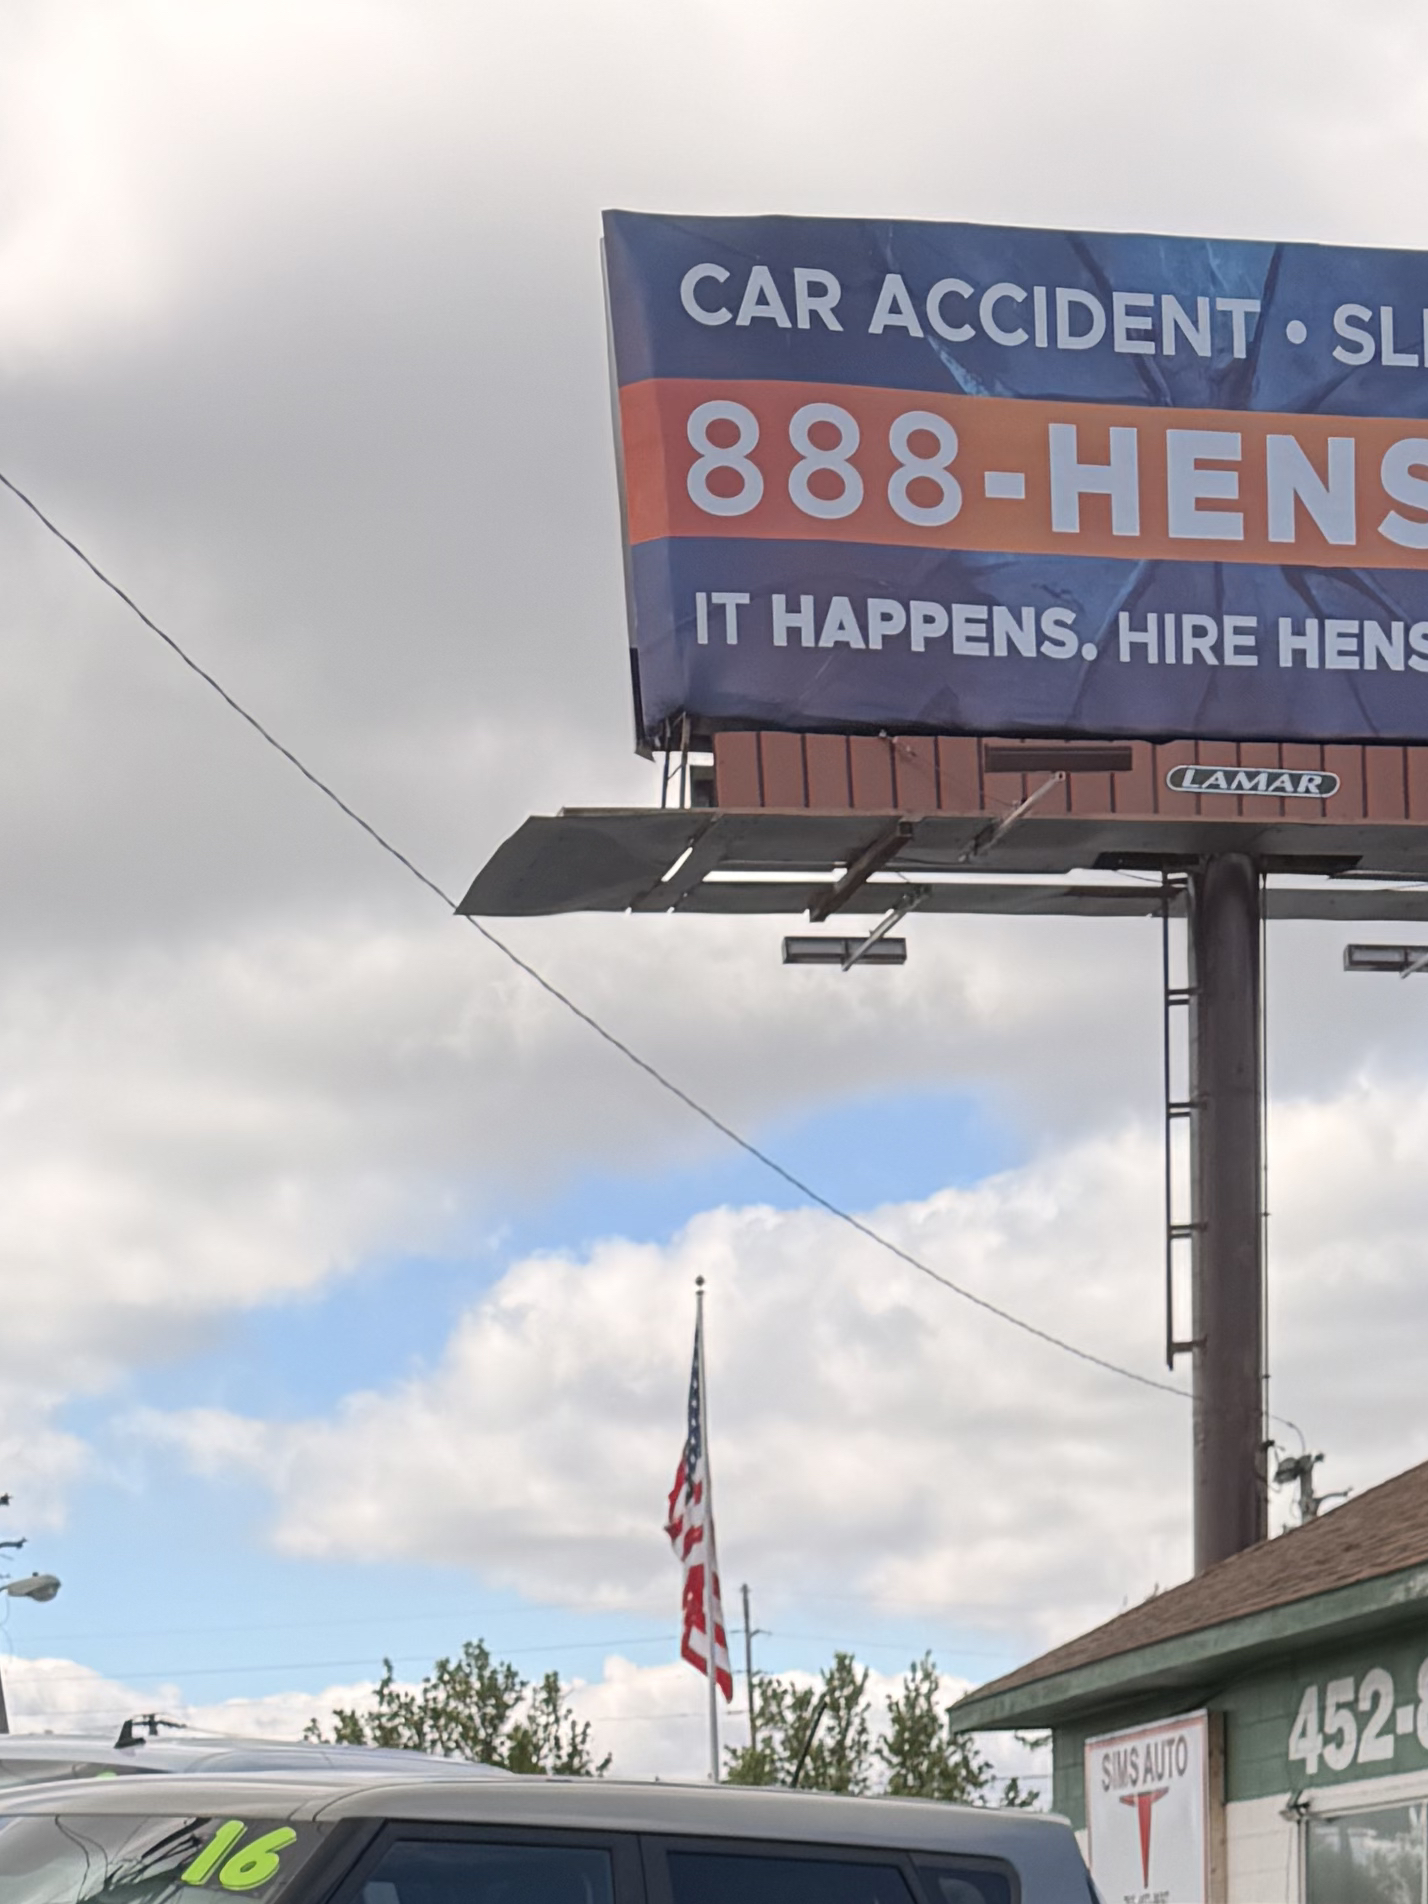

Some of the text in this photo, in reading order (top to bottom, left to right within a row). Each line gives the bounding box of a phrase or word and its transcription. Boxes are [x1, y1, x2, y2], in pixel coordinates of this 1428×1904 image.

[679, 262, 845, 333] CAR
[867, 276, 1263, 359] ACCIDENT
[692, 591, 751, 647] IT
[771, 594, 1099, 662] HAPPENS.
[1118, 612, 1258, 668] HIRE
[1181, 769, 1323, 794] LAMAR
[1102, 1734, 1188, 1792] SIMS AUTO
[181, 1820, 298, 1891] 16
